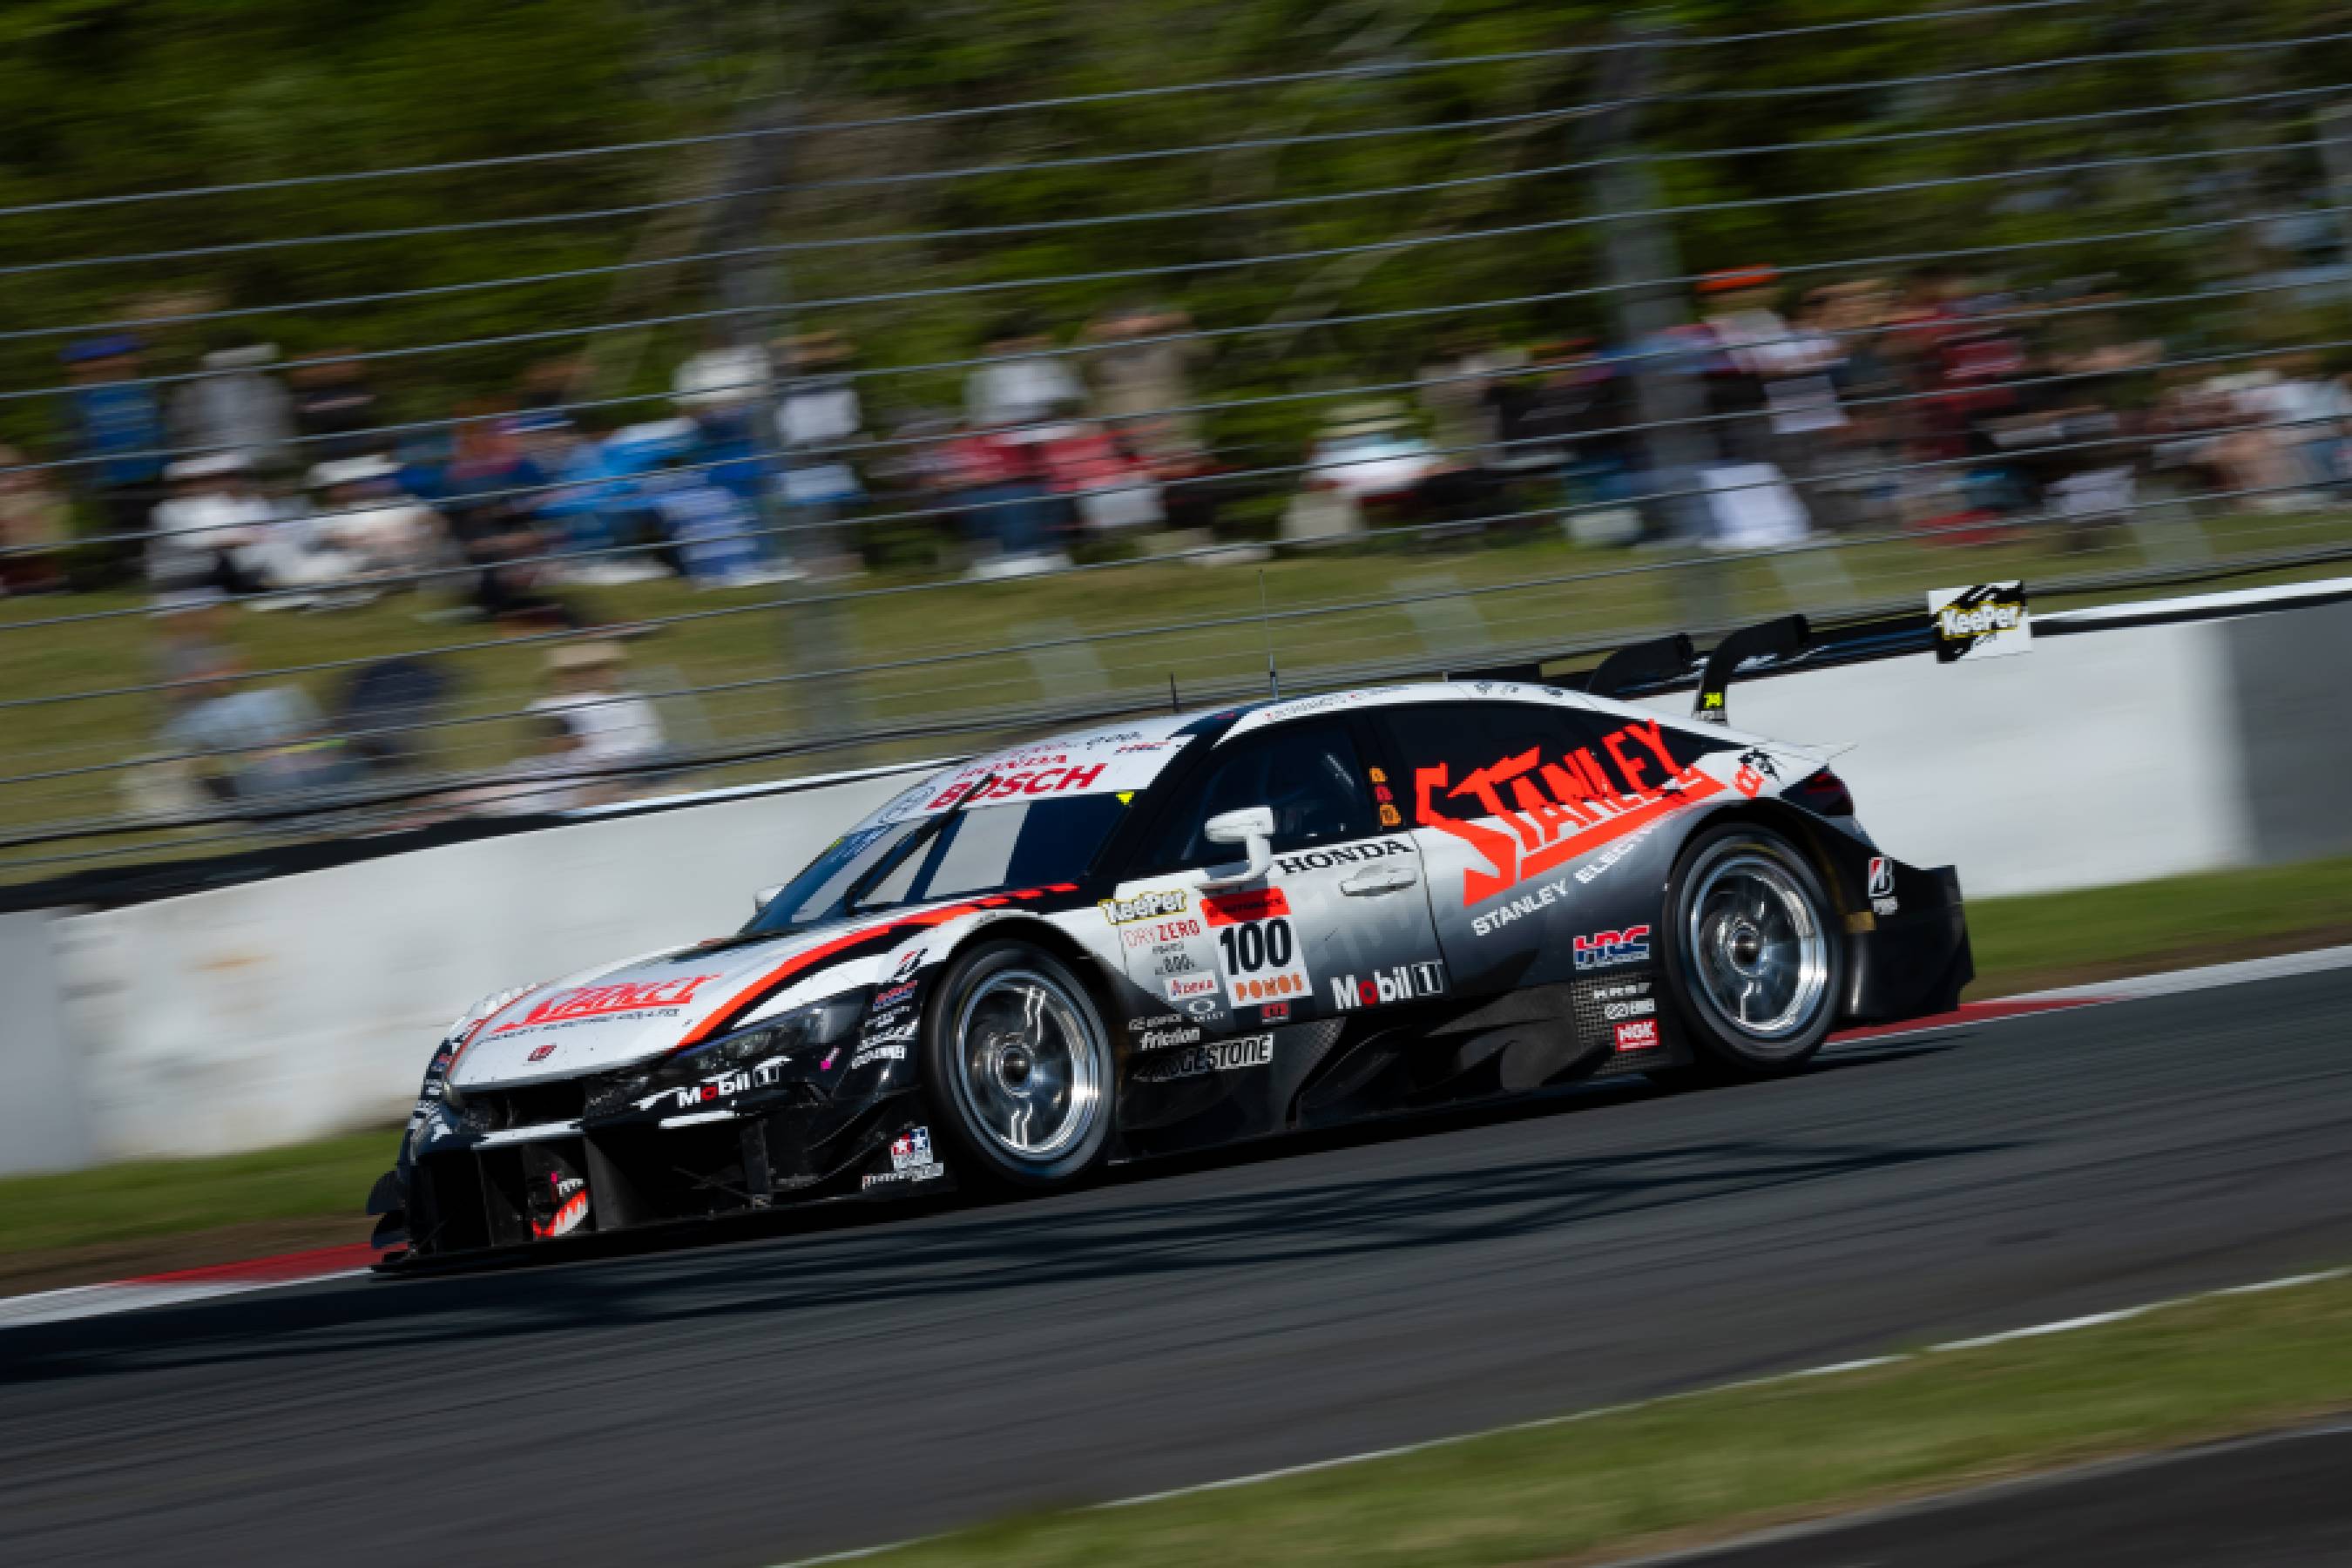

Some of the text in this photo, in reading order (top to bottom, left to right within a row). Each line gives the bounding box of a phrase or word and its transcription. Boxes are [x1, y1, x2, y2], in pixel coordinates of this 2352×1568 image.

[1942, 603, 2019, 637] KeePer
[925, 763, 1107, 810] BOSCH
[1415, 719, 1699, 908] STANLEY
[1278, 841, 1414, 875] HONDA
[1103, 890, 1186, 924] KeePer
[1470, 878, 1567, 936] STANLEY
[1220, 919, 1292, 976] 100
[1573, 925, 1650, 965] HRC
[1330, 966, 1414, 1011] Mobil
[1619, 1021, 1655, 1041] NGK
[677, 1071, 750, 1108] Mobil
